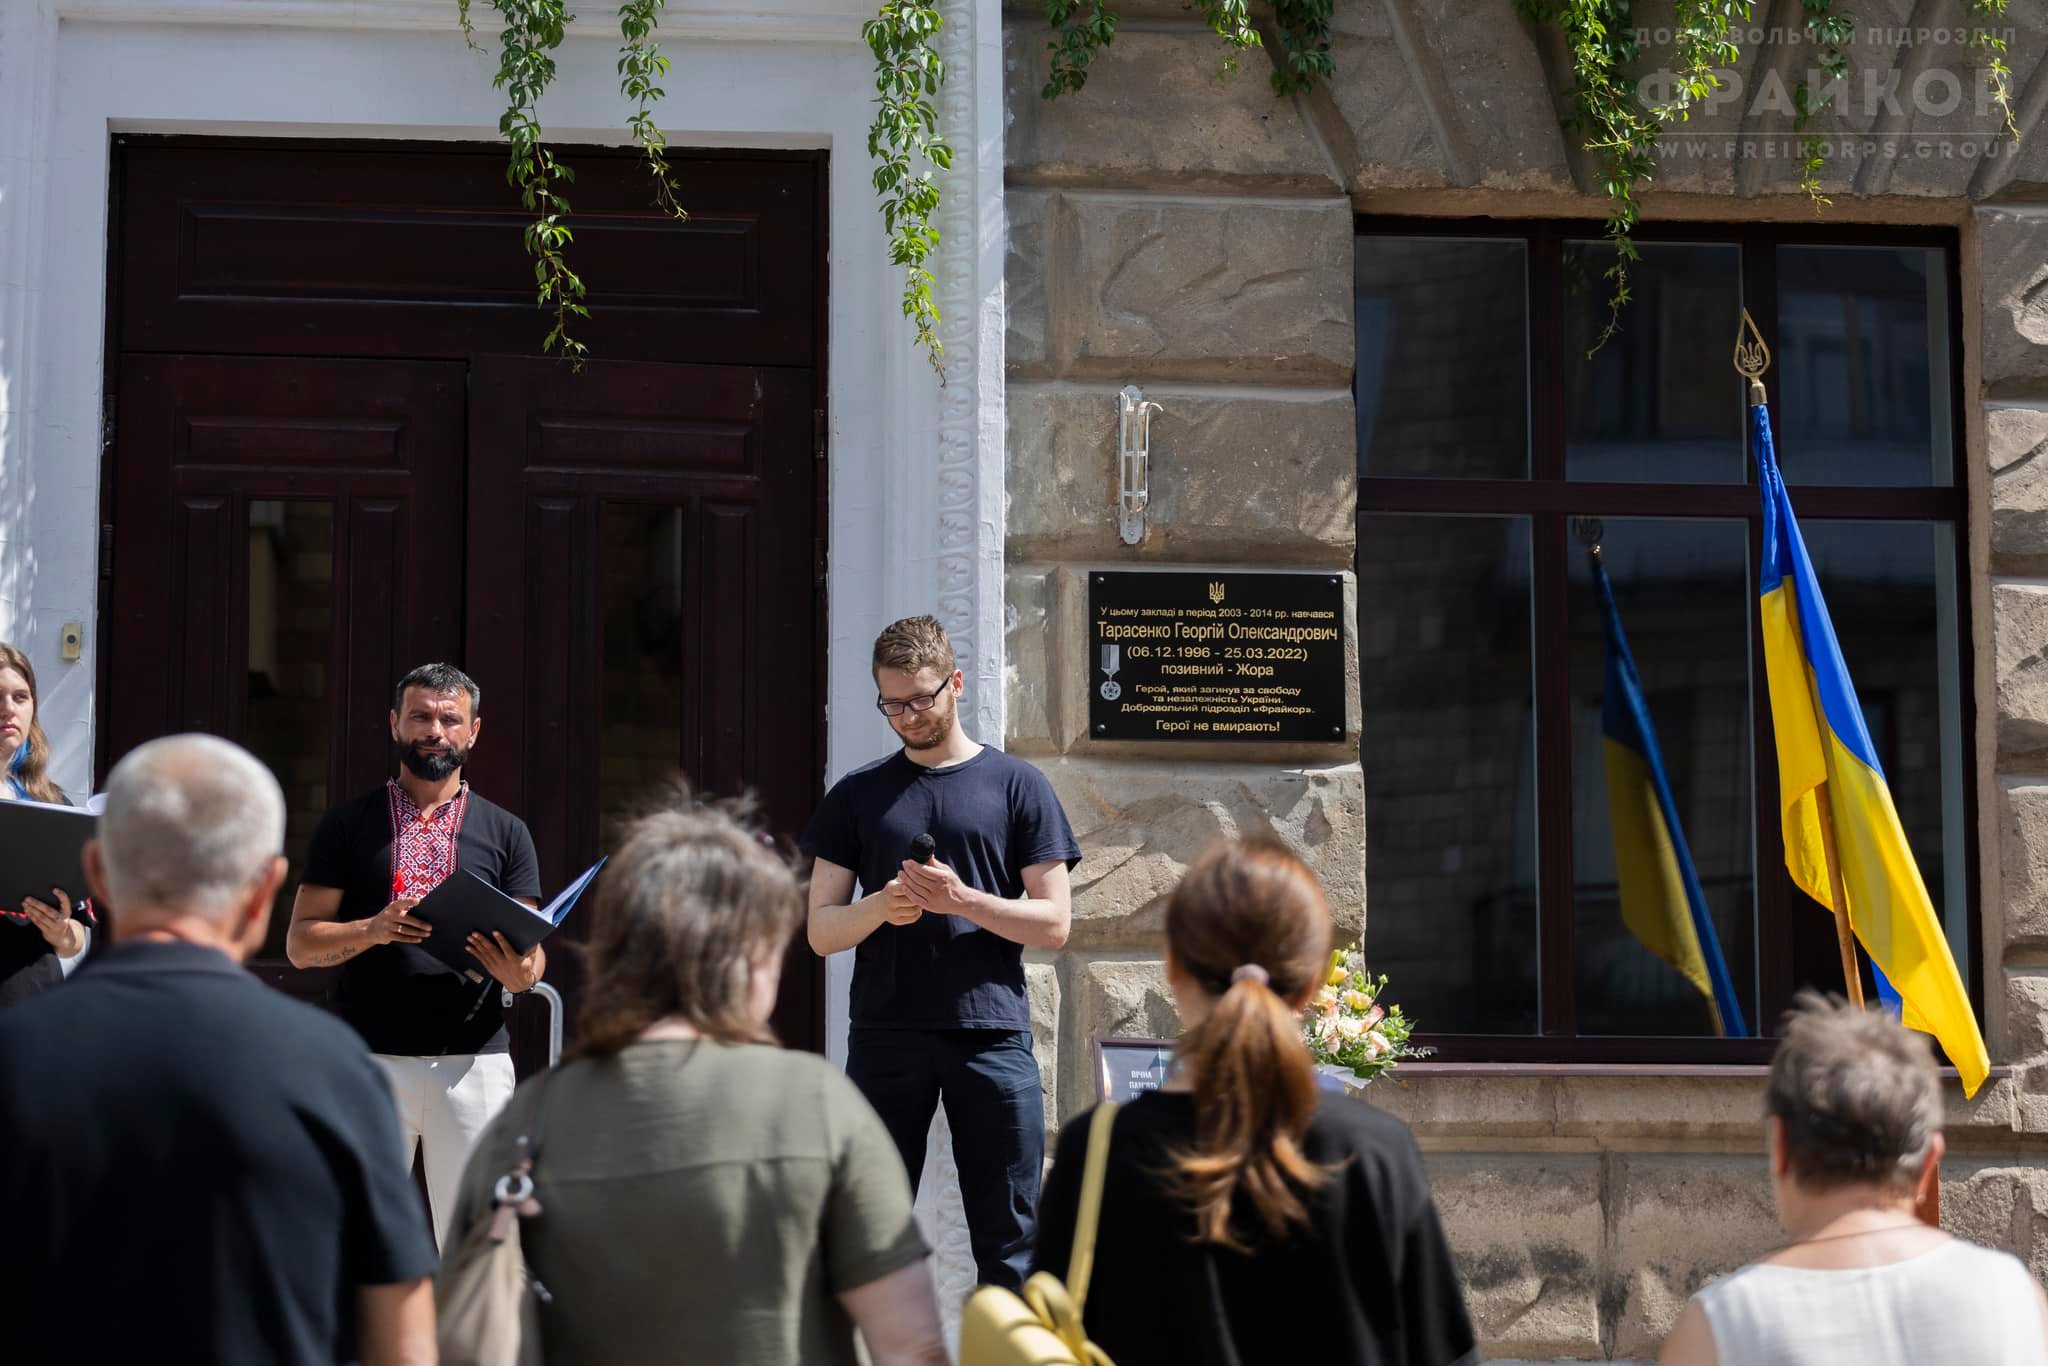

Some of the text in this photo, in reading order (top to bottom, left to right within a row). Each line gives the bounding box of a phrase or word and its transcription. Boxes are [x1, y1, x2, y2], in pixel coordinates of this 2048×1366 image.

[1100, 606, 1108, 616] У
[1110, 608, 1139, 618] цьому
[1141, 608, 1176, 618] закладі
[1178, 609, 1184, 617] в
[1186, 608, 1217, 619] період
[1218, 608, 1242, 618] 2003
[1249, 608, 1272, 618] 2014
[1274, 610, 1289, 620] рр.
[1291, 610, 1335, 619] навчався
[1097, 621, 1338, 644] Тарасенко Георгій Олександрович
[1127, 646, 1211, 660] (06.12.1996
[1224, 647, 1308, 662] 25.03.2022)
[1161, 663, 1224, 675] позивний
[1236, 663, 1275, 679] Жора
[1135, 684, 1302, 697] Герой, який загинув за свободу
[1152, 695, 1284, 705] та незалежність України.
[1121, 703, 1198, 713] Добровольчий
[1201, 704, 1250, 714] підрозділ
[1155, 719, 1281, 734] Герої не вмирають!
